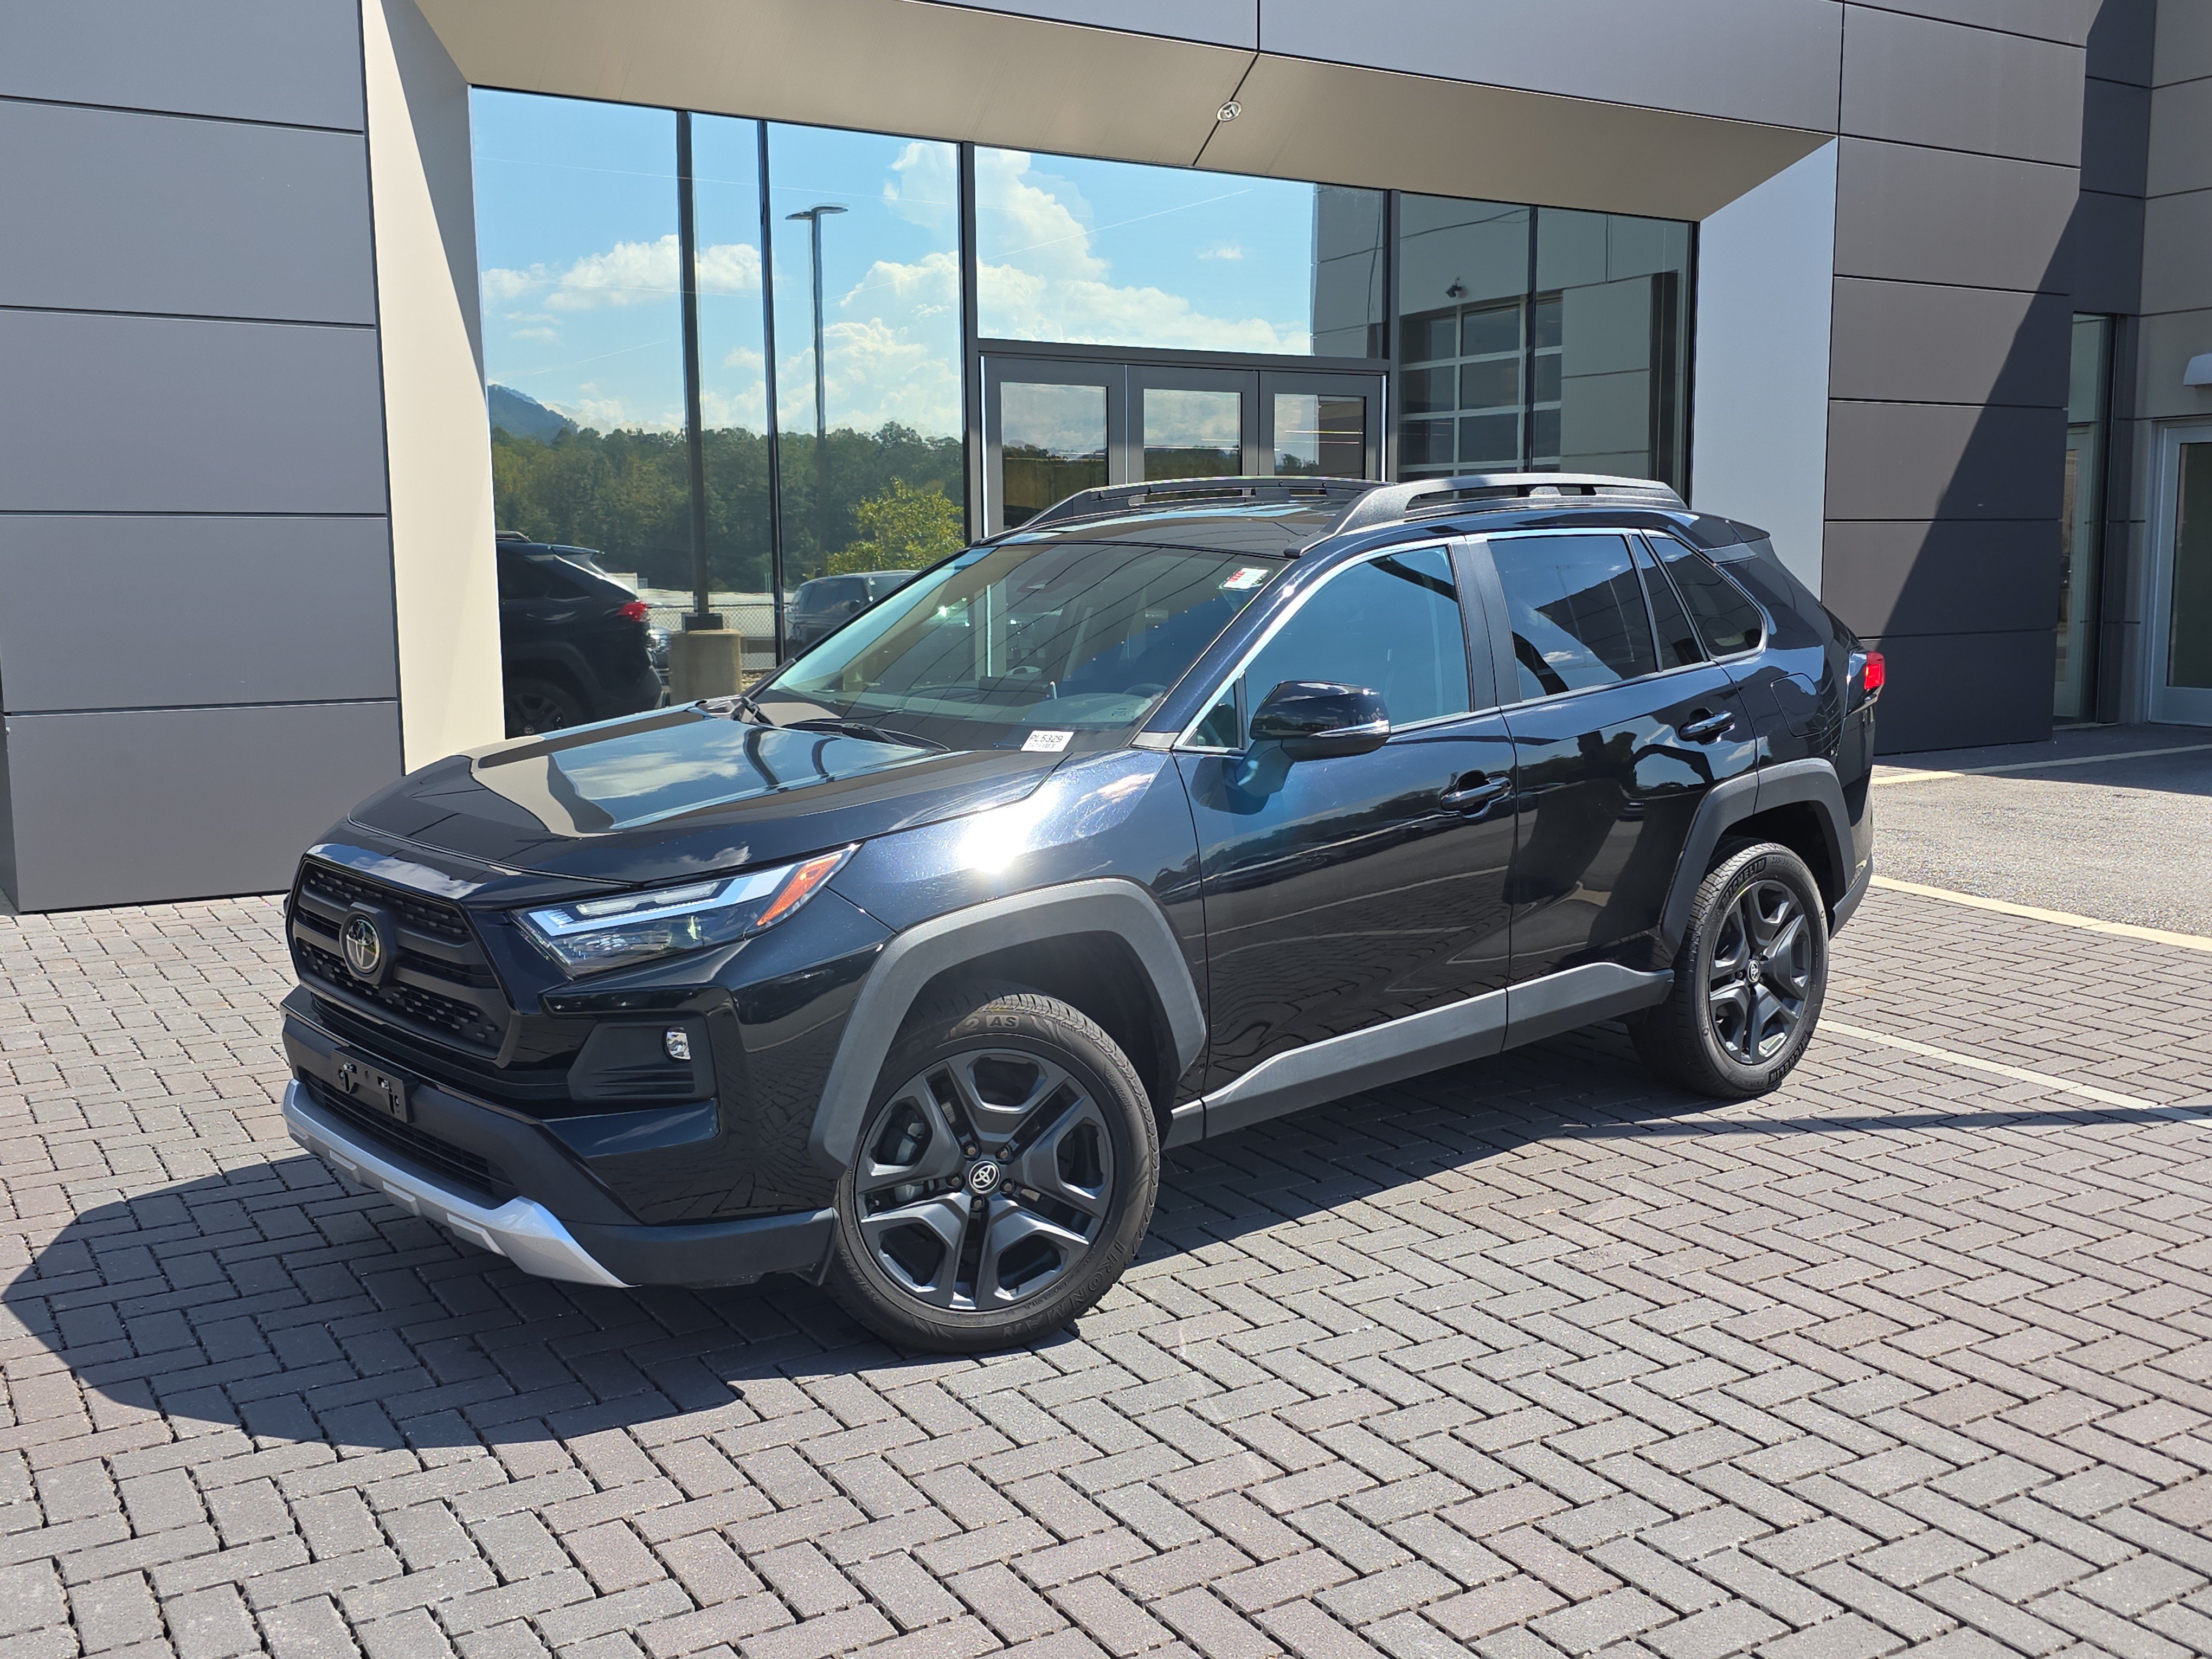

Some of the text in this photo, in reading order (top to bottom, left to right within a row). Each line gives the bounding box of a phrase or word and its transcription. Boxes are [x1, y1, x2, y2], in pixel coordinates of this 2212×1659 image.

[1030, 735, 1063, 743] PL5329
[1722, 859, 1765, 907] MICHELIN
[990, 1016, 1017, 1027] AS
[1770, 1032, 1809, 1084] MICHELIN
[1002, 1239, 1126, 1339] IRONMAN
